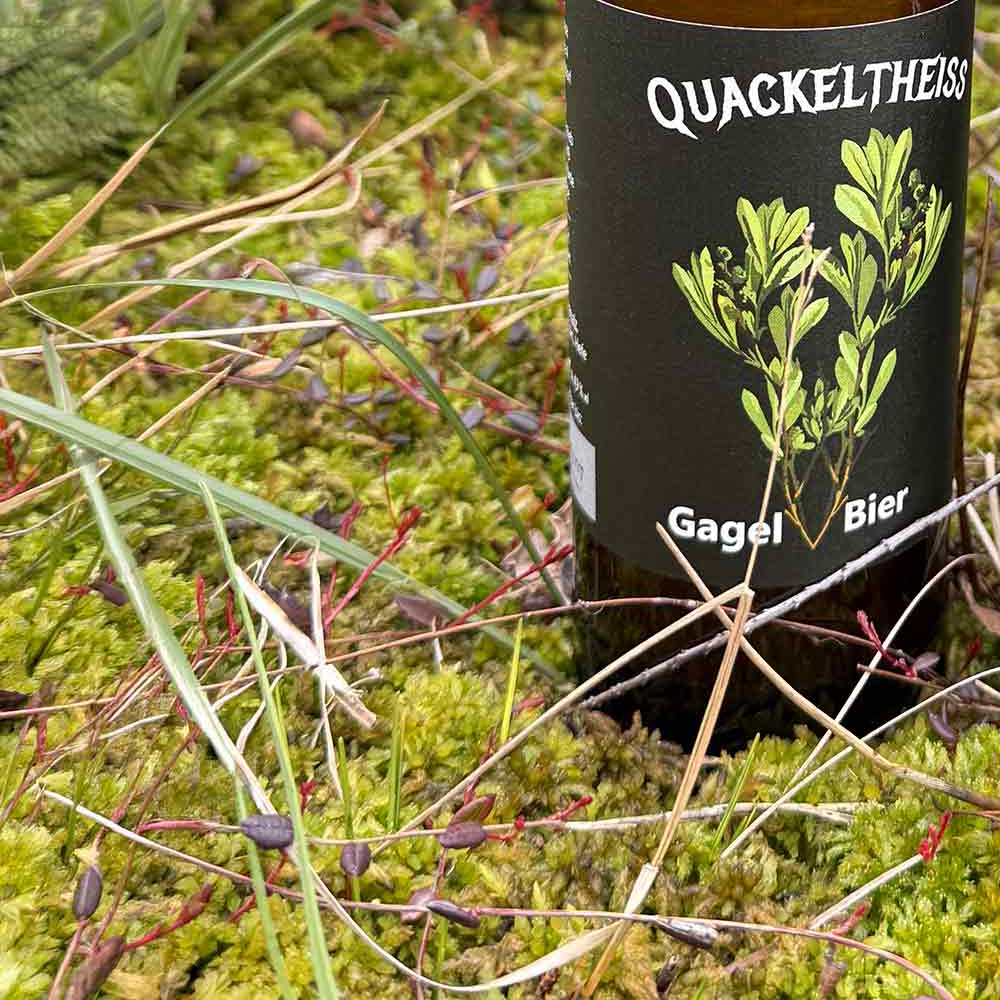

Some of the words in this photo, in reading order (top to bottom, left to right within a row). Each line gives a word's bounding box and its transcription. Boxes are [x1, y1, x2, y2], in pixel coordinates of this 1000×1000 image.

[646, 52, 968, 140] QUACKELTHEISS
[667, 506, 783, 553] Gagel
[844, 487, 909, 533] Bier
